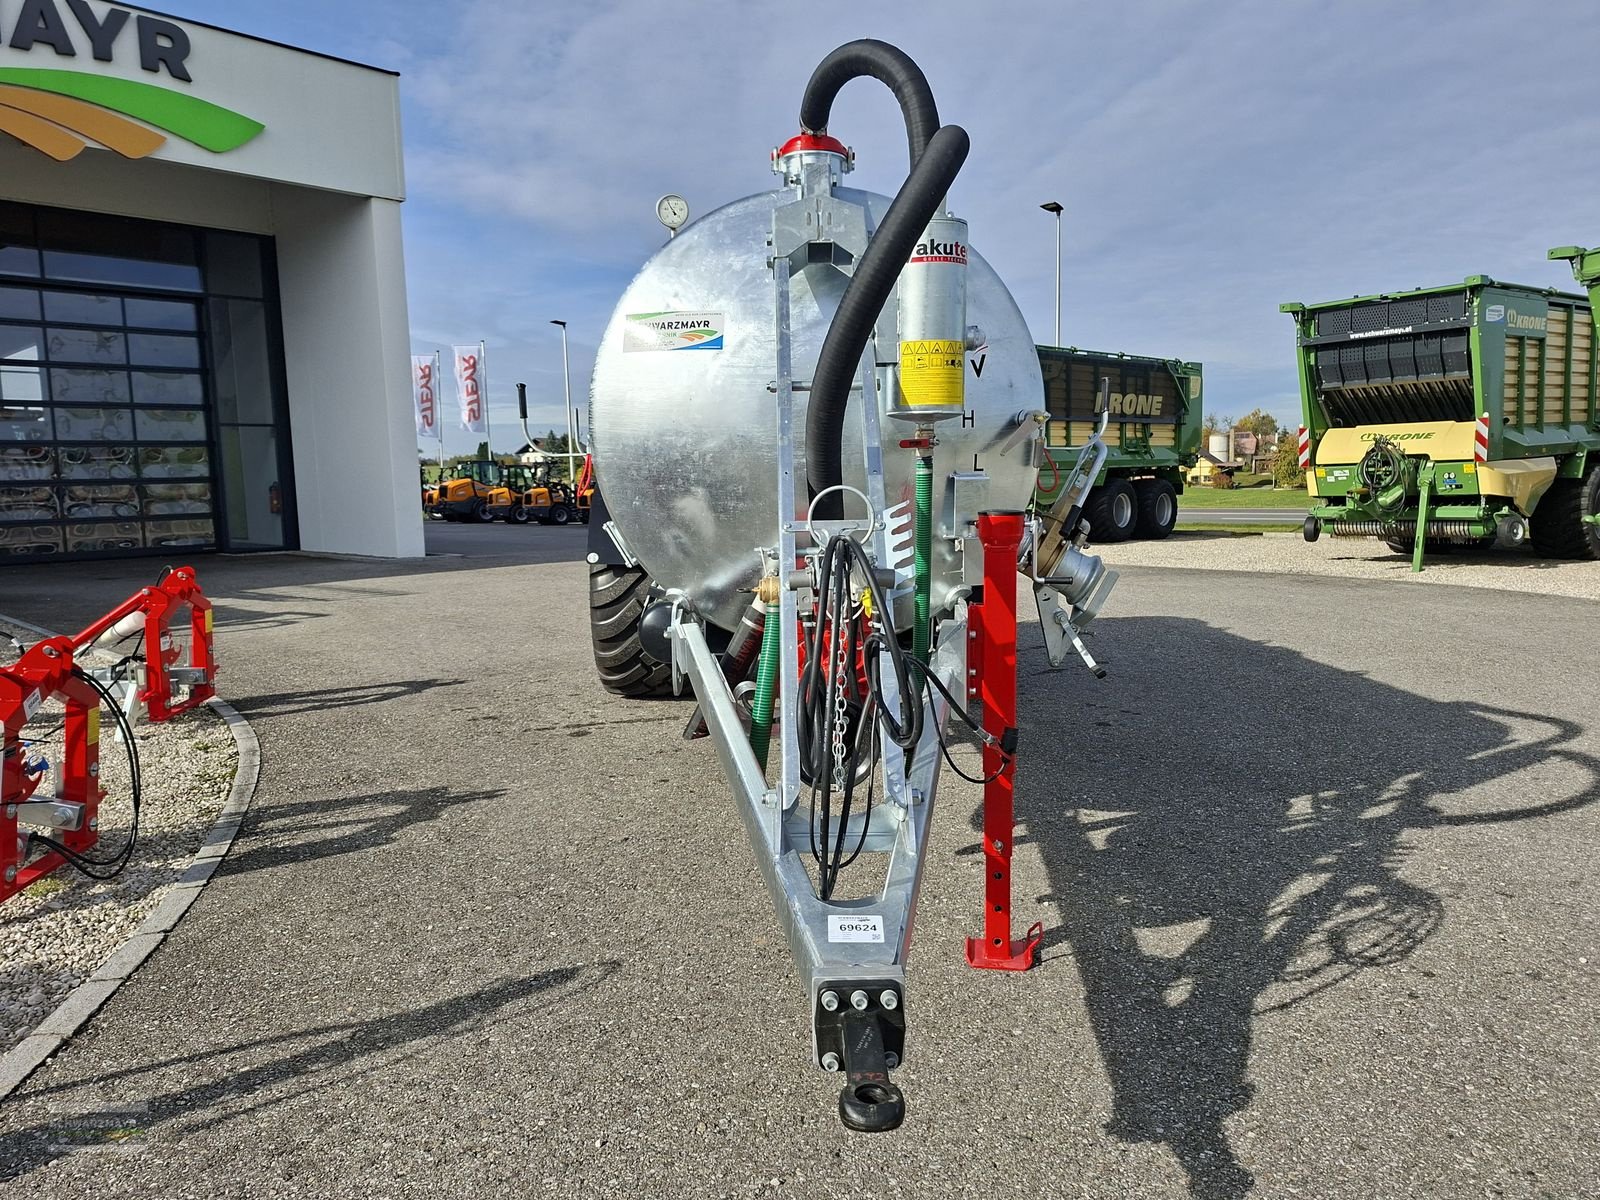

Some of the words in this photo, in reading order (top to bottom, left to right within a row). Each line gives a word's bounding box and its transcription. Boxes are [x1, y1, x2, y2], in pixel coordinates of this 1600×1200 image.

[0, 0, 193, 83] AYR
[916, 238, 967, 258] akute
[1516, 314, 1547, 330] KRONE
[962, 410, 974, 428] H
[1385, 432, 1436, 441] RONE
[973, 453, 984, 472] L
[839, 924, 877, 932] 69624
